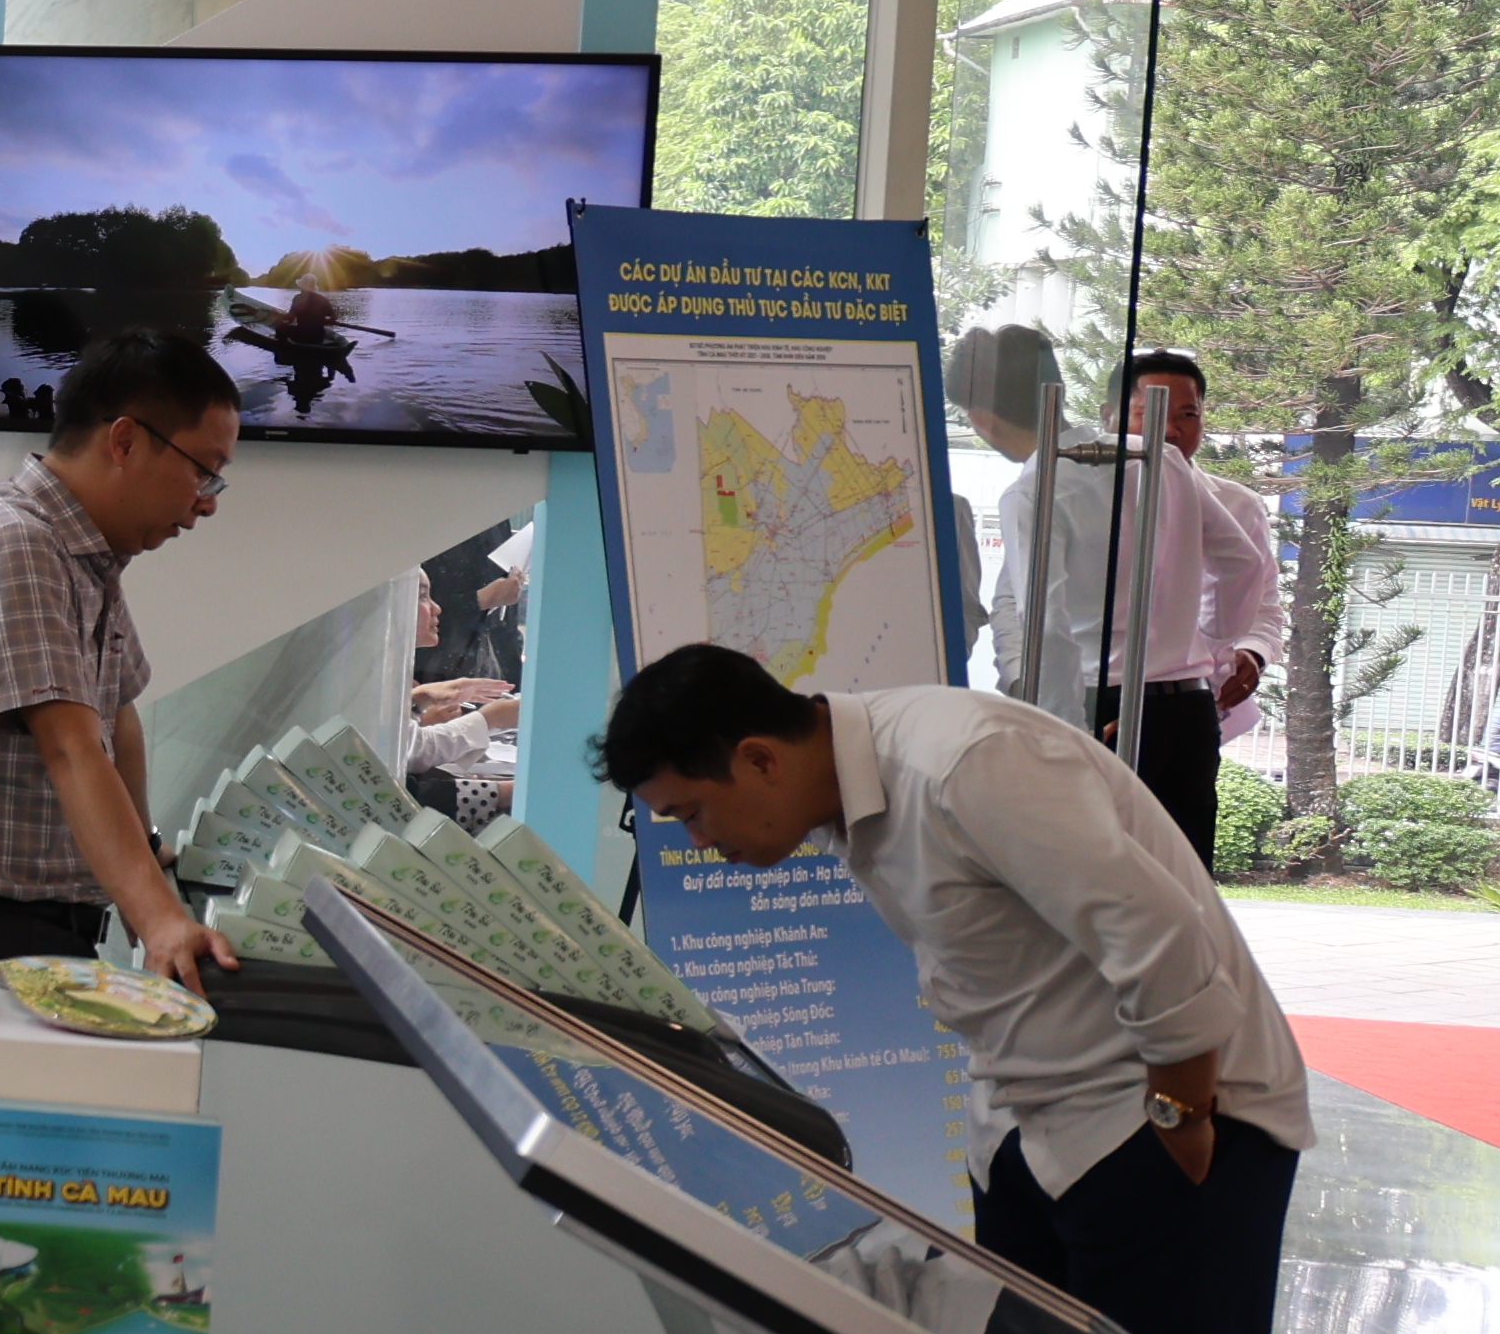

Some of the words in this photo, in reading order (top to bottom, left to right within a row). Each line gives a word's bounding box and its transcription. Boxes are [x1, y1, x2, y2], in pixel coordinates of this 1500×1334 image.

[619, 258, 656, 282] CÁC
[660, 262, 682, 288] DỰ
[685, 260, 707, 284] ÁN
[710, 258, 740, 286] ĐẦU
[744, 267, 764, 287] TƯ
[766, 268, 787, 291] TẠI
[791, 265, 824, 289] CÁC
[829, 271, 862, 293] KCN,
[867, 273, 891, 291] KKT
[608, 292, 652, 317] ĐƯỢC
[657, 290, 678, 314] ÁP
[681, 297, 724, 319] DỤNG
[728, 292, 756, 317] THỦ
[758, 299, 787, 322] TỤC
[791, 292, 821, 319] ĐẦU
[825, 299, 842, 319] TƯ
[845, 302, 876, 325] ĐẶC
[880, 299, 908, 326] BIỆT
[683, 873, 704, 893] Quỹ
[707, 869, 724, 889] đất
[727, 870, 752, 891] công
[755, 867, 790, 889] nghiệp
[793, 865, 809, 882] lớn
[671, 936, 681, 952] 1.
[682, 934, 704, 951] Khu
[706, 932, 733, 952] công
[735, 927, 772, 949] nghiệp
[774, 924, 808, 943] Khánh
[810, 924, 828, 940] An:
[61, 1178, 99, 1205] CÀ
[107, 1184, 169, 1209] MAU
